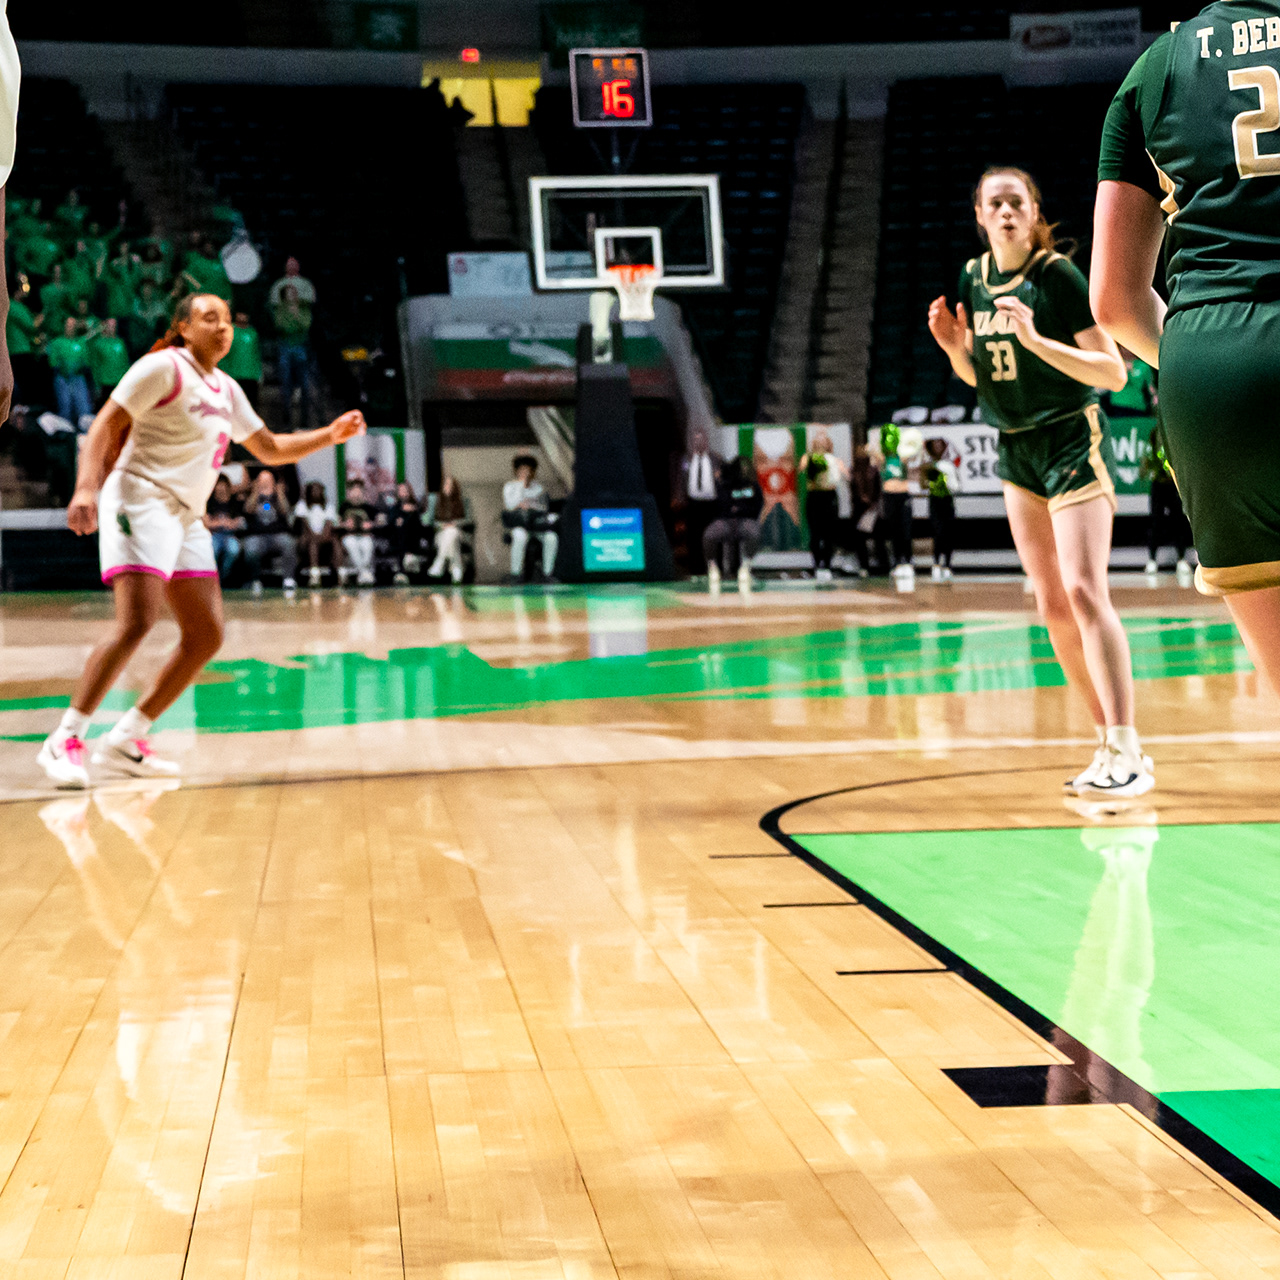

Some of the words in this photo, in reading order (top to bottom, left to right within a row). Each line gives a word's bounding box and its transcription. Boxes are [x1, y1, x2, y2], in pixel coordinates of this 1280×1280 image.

[1196, 26, 1223, 59] T.
[602, 79, 635, 118] 16
[985, 340, 1018, 382] 33
